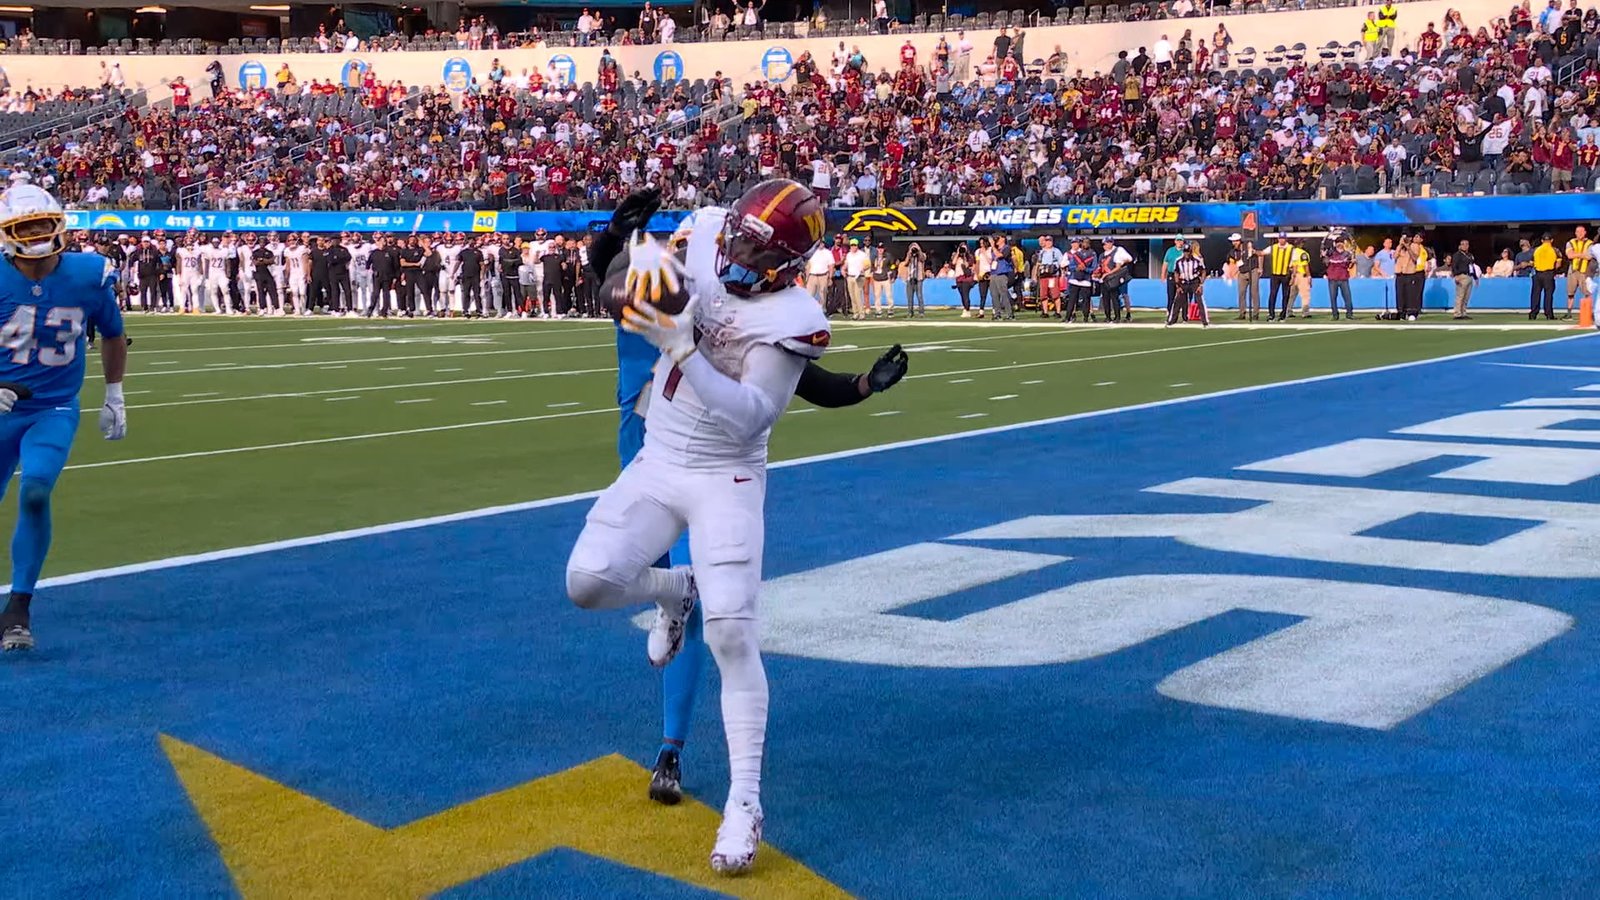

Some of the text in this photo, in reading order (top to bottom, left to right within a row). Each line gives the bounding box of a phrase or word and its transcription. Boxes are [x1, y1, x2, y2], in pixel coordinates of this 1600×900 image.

[847, 135, 857, 145] 21
[133, 215, 150, 226] 10
[166, 215, 216, 227] 4TH & 7
[476, 216, 495, 227] 40
[927, 206, 1180, 230] LOS ANGELES CHARGERS
[1242, 212, 1256, 230] 4
[184, 257, 197, 268] 26
[211, 257, 223, 268] 22
[0, 304, 85, 367] 43
